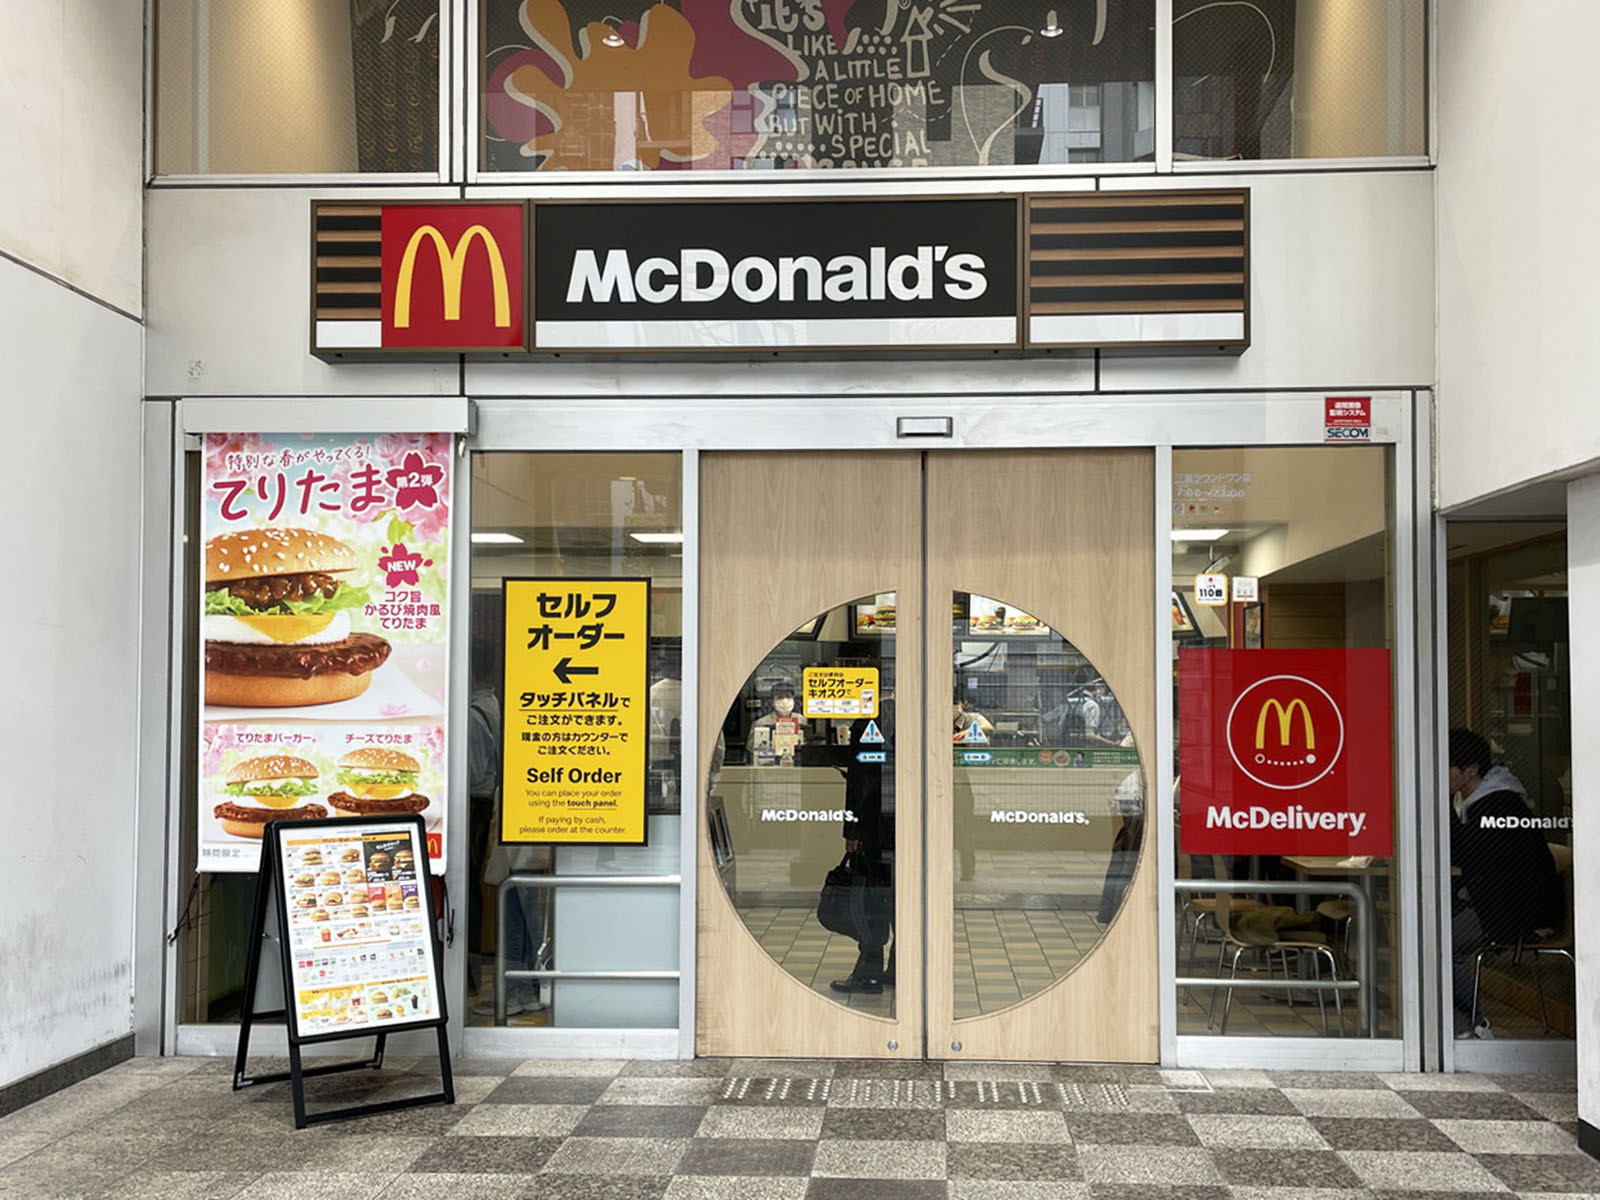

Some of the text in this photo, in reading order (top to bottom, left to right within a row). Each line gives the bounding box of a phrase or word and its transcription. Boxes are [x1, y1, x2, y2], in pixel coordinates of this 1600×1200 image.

[787, 34, 836, 57] LIKE
[815, 58, 901, 81] A LITTLE
[844, 87, 864, 104] OF
[868, 80, 945, 108] HOME
[768, 113, 807, 136] BUT
[566, 246, 988, 303] McDonald's
[1327, 428, 1369, 438] SECOM
[213, 463, 387, 521] てりたま
[387, 560, 416, 572] NEW
[385, 591, 421, 602] コク旨
[1199, 588, 1223, 598] 110
[364, 604, 441, 616] かるび焼肉風
[536, 592, 617, 618] セルフ
[379, 617, 427, 629] てりたま
[527, 623, 625, 650] オーダー
[808, 678, 874, 688] セルフオーダー
[520, 692, 631, 708] タッチパネルで
[345, 733, 413, 744] チーズてりたま
[521, 732, 628, 742] 現金の方はカウンターで
[526, 768, 622, 783] Self Order
[558, 789, 580, 798] place
[582, 790, 599, 798] your
[600, 789, 622, 797] order
[528, 800, 551, 808] using
[567, 799, 592, 807] touch
[546, 816, 572, 825] paying
[573, 816, 583, 825] by
[519, 826, 546, 834] please
